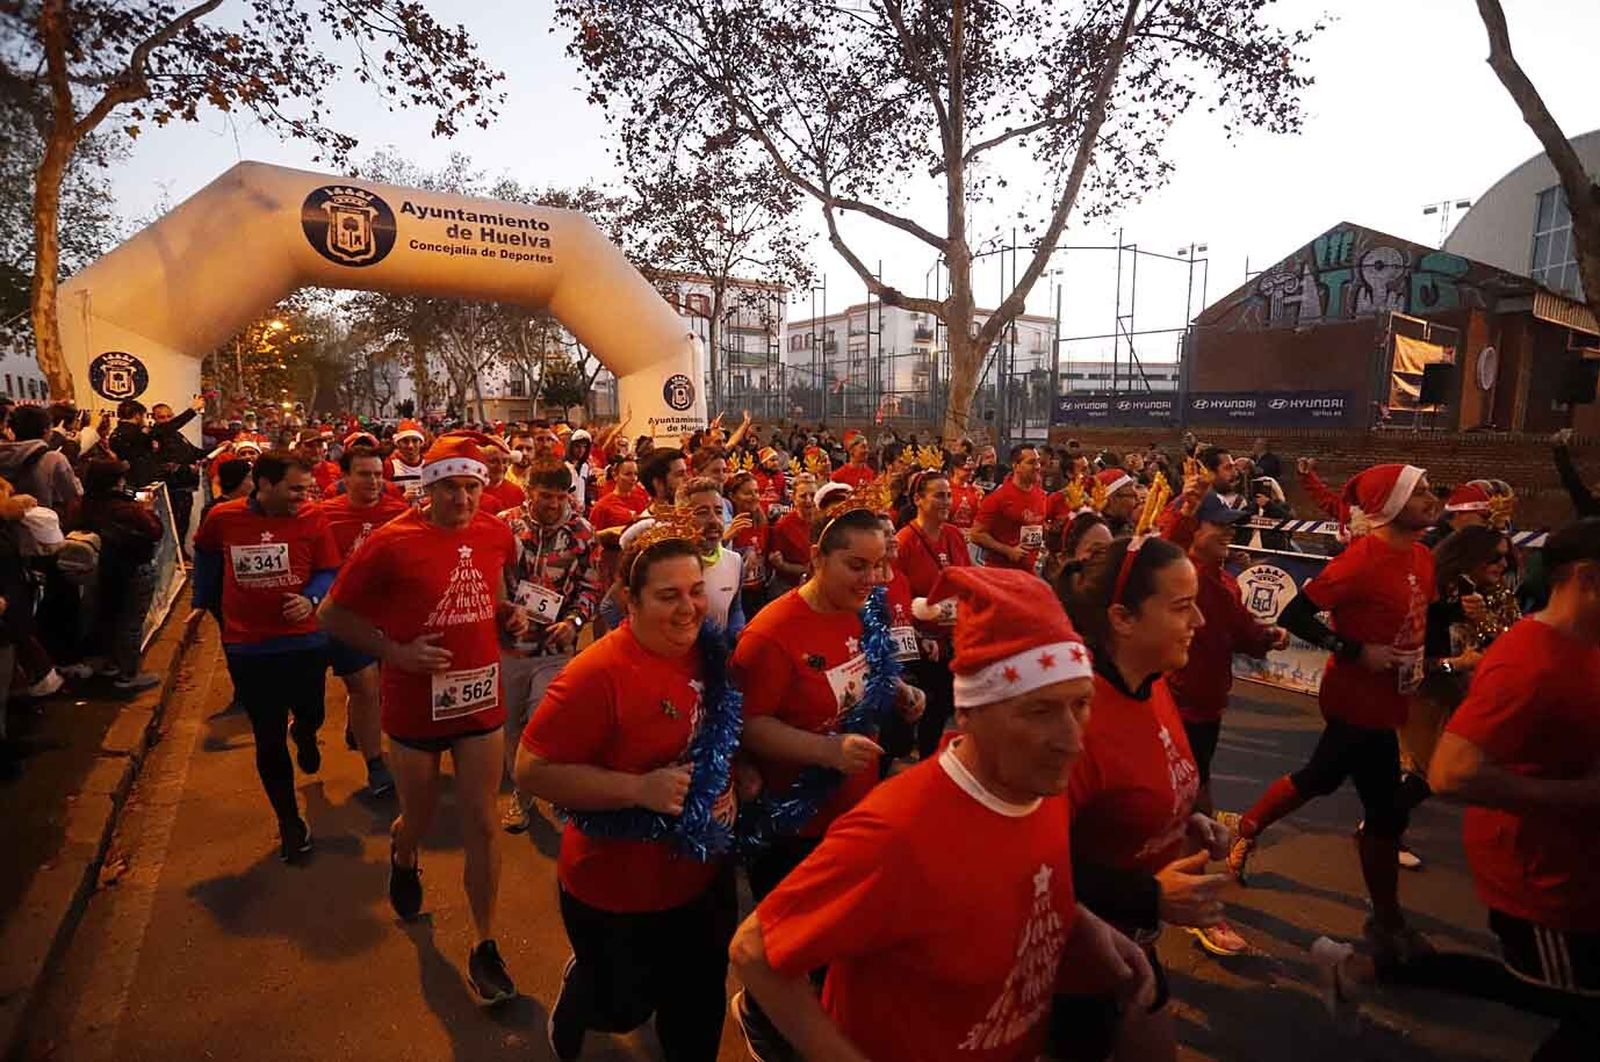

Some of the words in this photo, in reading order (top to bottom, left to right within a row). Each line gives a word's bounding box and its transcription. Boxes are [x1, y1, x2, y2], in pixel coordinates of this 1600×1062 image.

[400, 201, 550, 232] Ayuntamiento
[446, 224, 472, 240] de
[480, 227, 550, 249] Huelva
[481, 247, 496, 258] de
[500, 249, 554, 264] Deportes
[1074, 401, 1108, 409] HYUNDAI
[1132, 401, 1171, 409] HYUNDAI
[1210, 400, 1256, 408] HYUNDAI
[1290, 399, 1344, 408] HYUNDAI
[254, 555, 282, 570] 341
[538, 598, 549, 612] 5
[462, 679, 493, 702] 562
